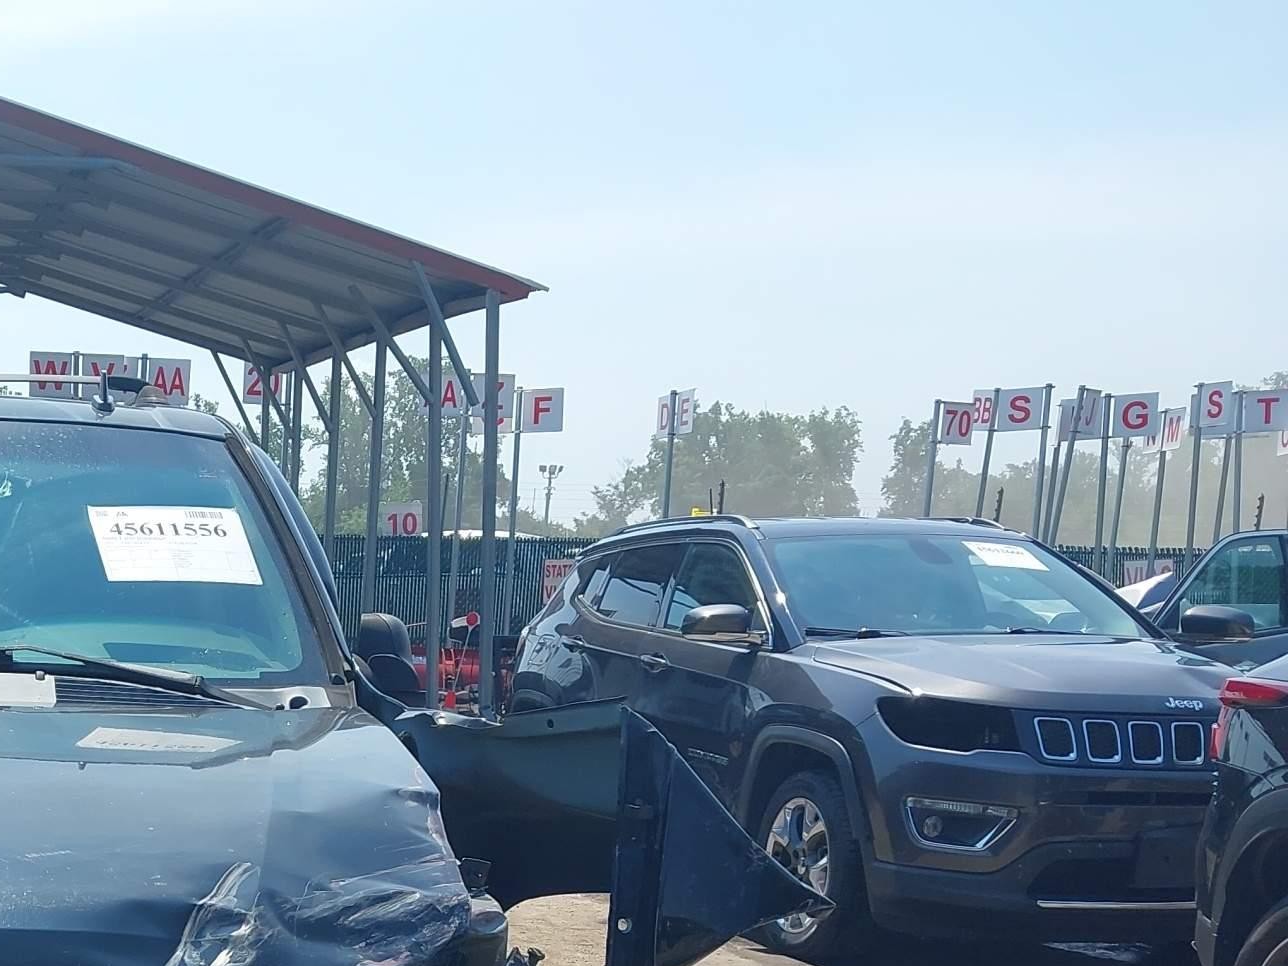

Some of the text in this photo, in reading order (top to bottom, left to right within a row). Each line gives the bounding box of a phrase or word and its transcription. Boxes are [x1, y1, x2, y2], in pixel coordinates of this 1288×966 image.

[33, 359, 68, 391] W
[153, 366, 185, 396] AA
[533, 396, 553, 425] F
[679, 397, 690, 427] E
[1007, 395, 1032, 424] S
[1122, 400, 1149, 430] G
[1207, 389, 1224, 419] S
[1256, 397, 1280, 425] T
[945, 409, 972, 438] 70
[1166, 415, 1182, 443] M
[110, 521, 228, 538] 45611556
[387, 512, 418, 536] 10
[1165, 696, 1204, 711] Jeep
